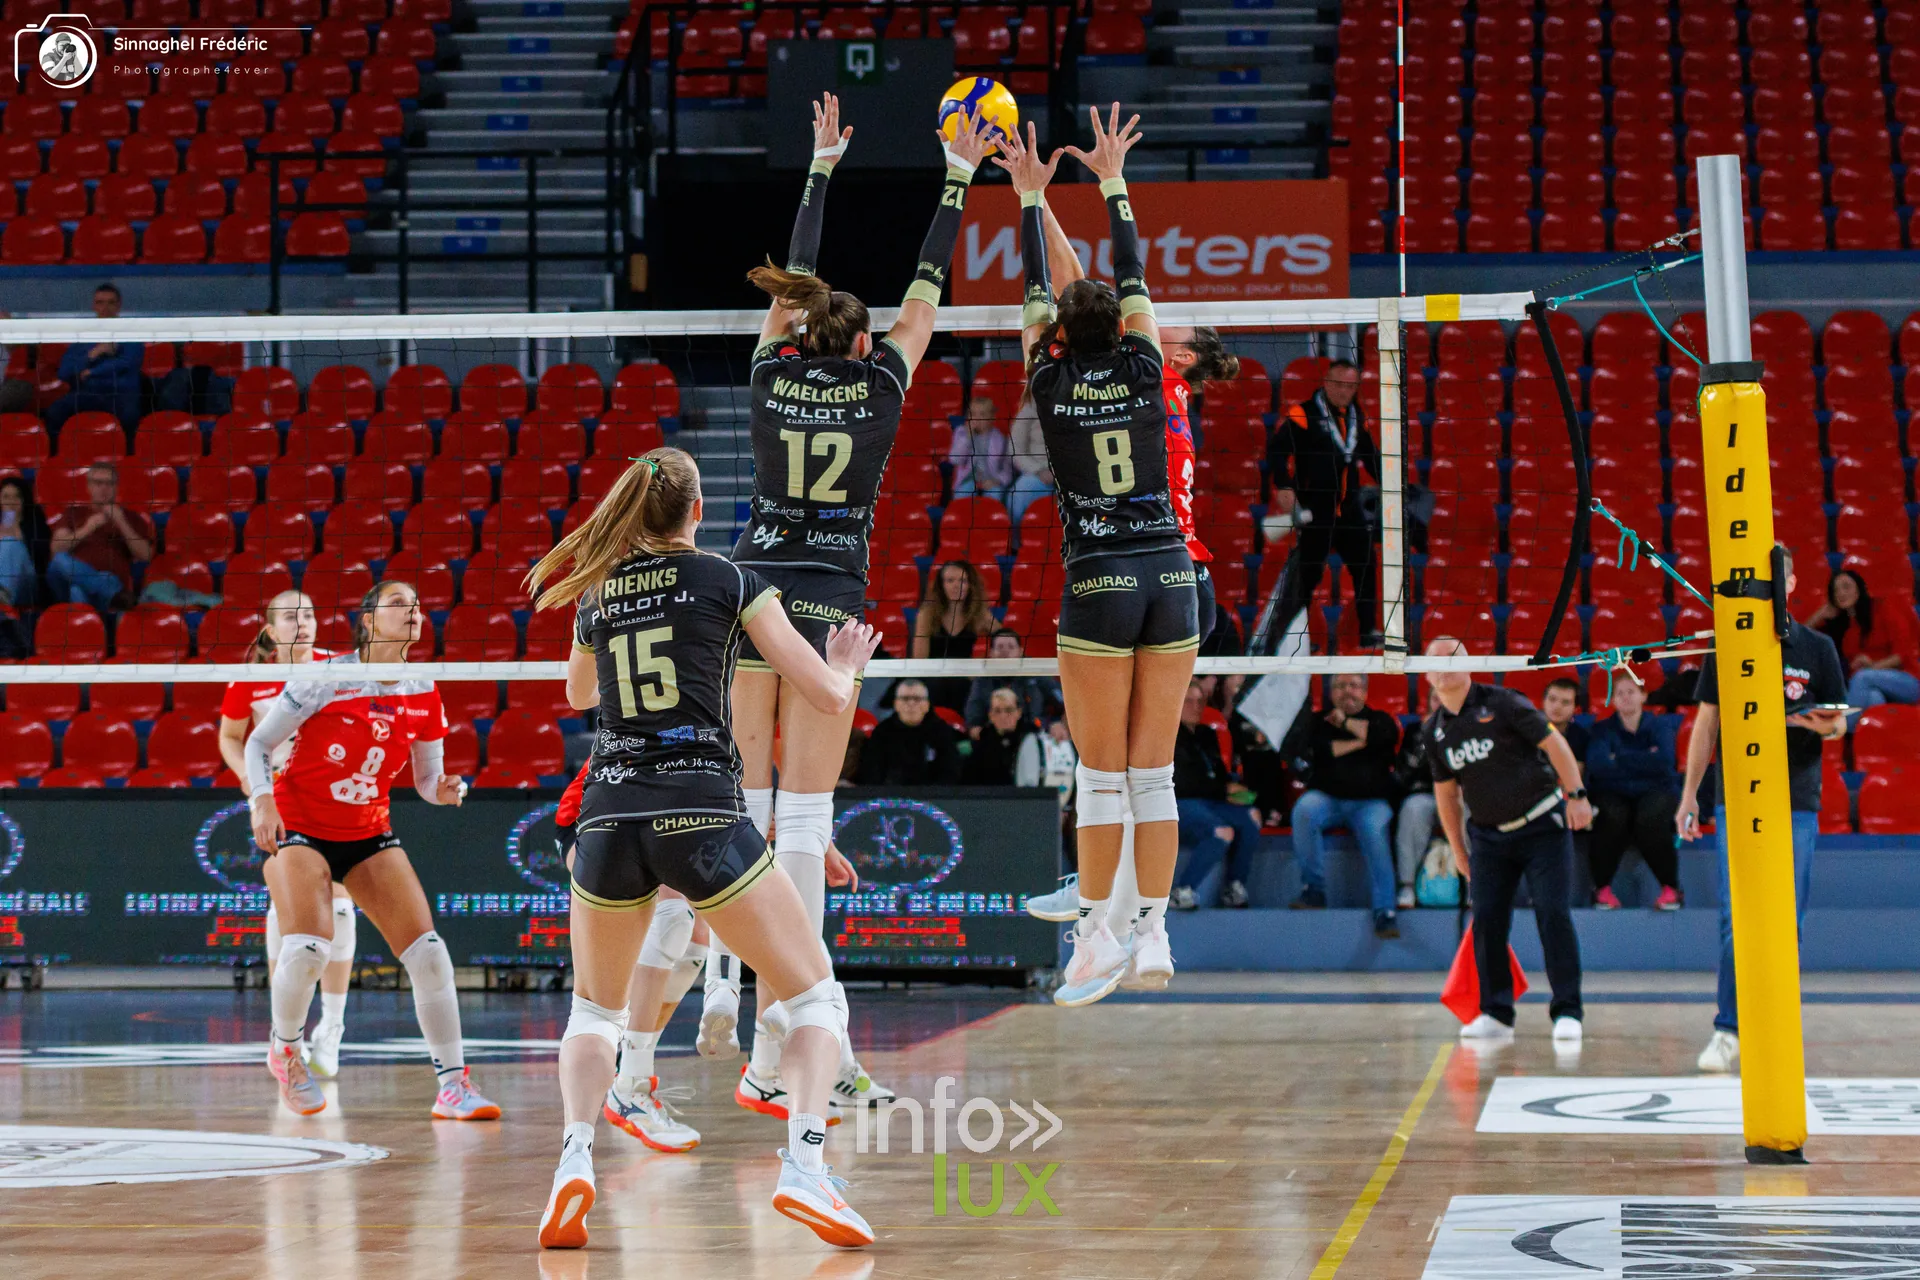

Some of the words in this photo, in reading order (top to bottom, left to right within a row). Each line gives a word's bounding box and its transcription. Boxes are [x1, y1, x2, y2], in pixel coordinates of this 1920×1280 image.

[941, 185, 964, 211] 12
[1117, 199, 1134, 222] 8
[772, 376, 869, 403] WAELKENS
[1073, 382, 1130, 401] Moulin
[765, 399, 846, 420] PIRLOT
[854, 406, 874, 419] J.
[1053, 402, 1128, 417] PIRLOT
[779, 428, 853, 503] 12
[1092, 429, 1135, 496] 8
[604, 567, 678, 600] RIENKS
[1072, 575, 1138, 595] CHAURACI
[1160, 570, 1197, 584] CHAU
[591, 593, 667, 625] PIRLOT
[674, 590, 695, 602] J.
[608, 625, 680, 719] 15
[360, 746, 386, 777] 8
